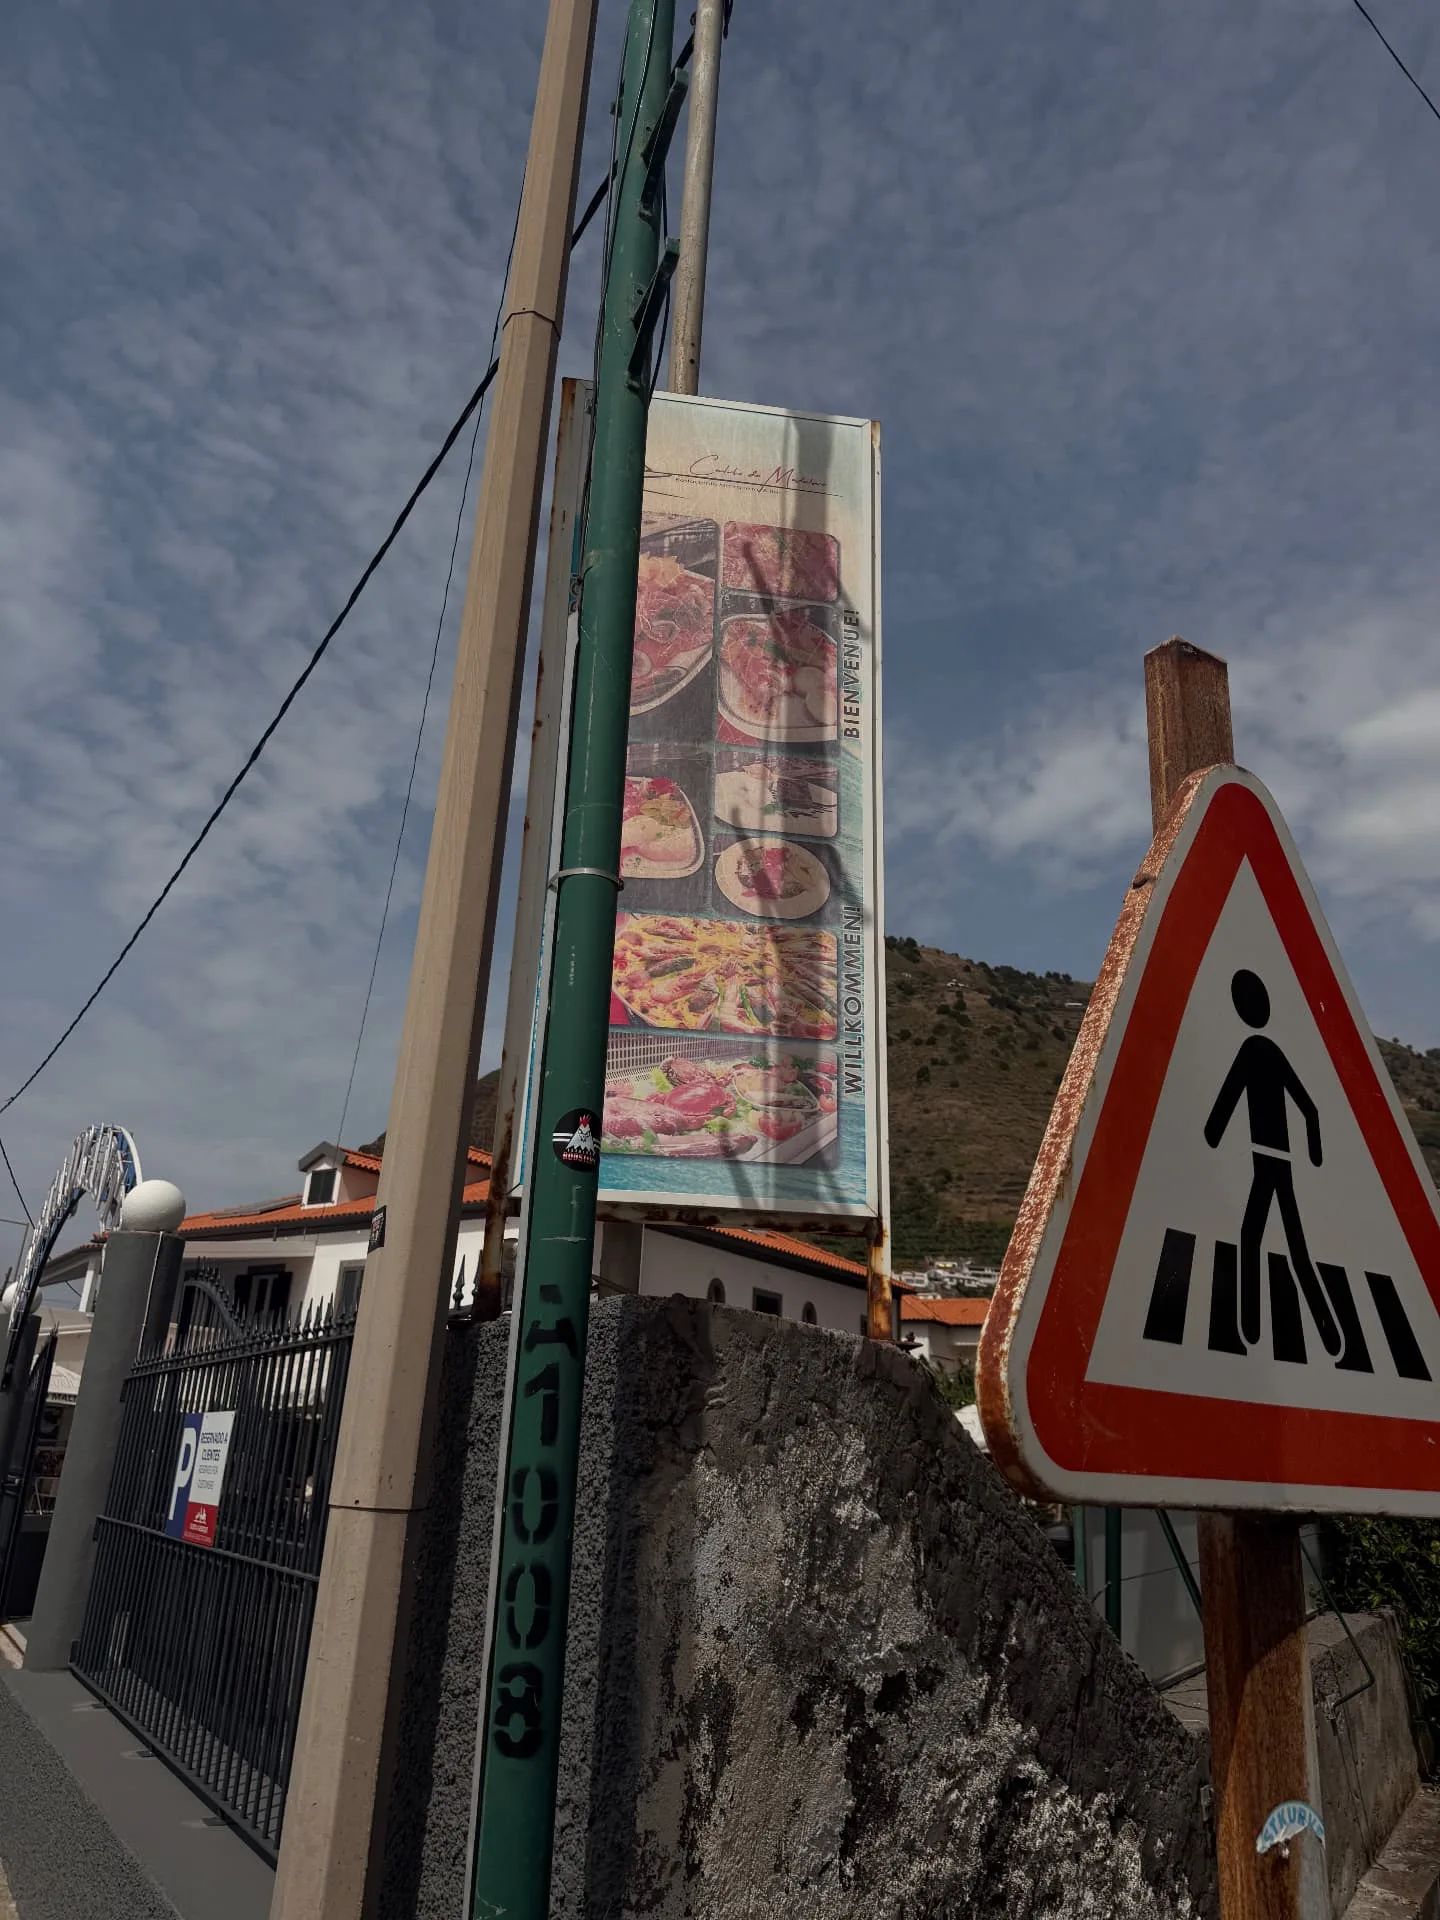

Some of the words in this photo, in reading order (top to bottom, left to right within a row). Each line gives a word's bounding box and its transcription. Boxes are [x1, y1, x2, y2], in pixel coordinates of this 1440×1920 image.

[843, 609, 860, 739] BIENVENUE!
[843, 906, 862, 1094] WILLKOMMEN!
[168, 1427, 197, 1520] P
